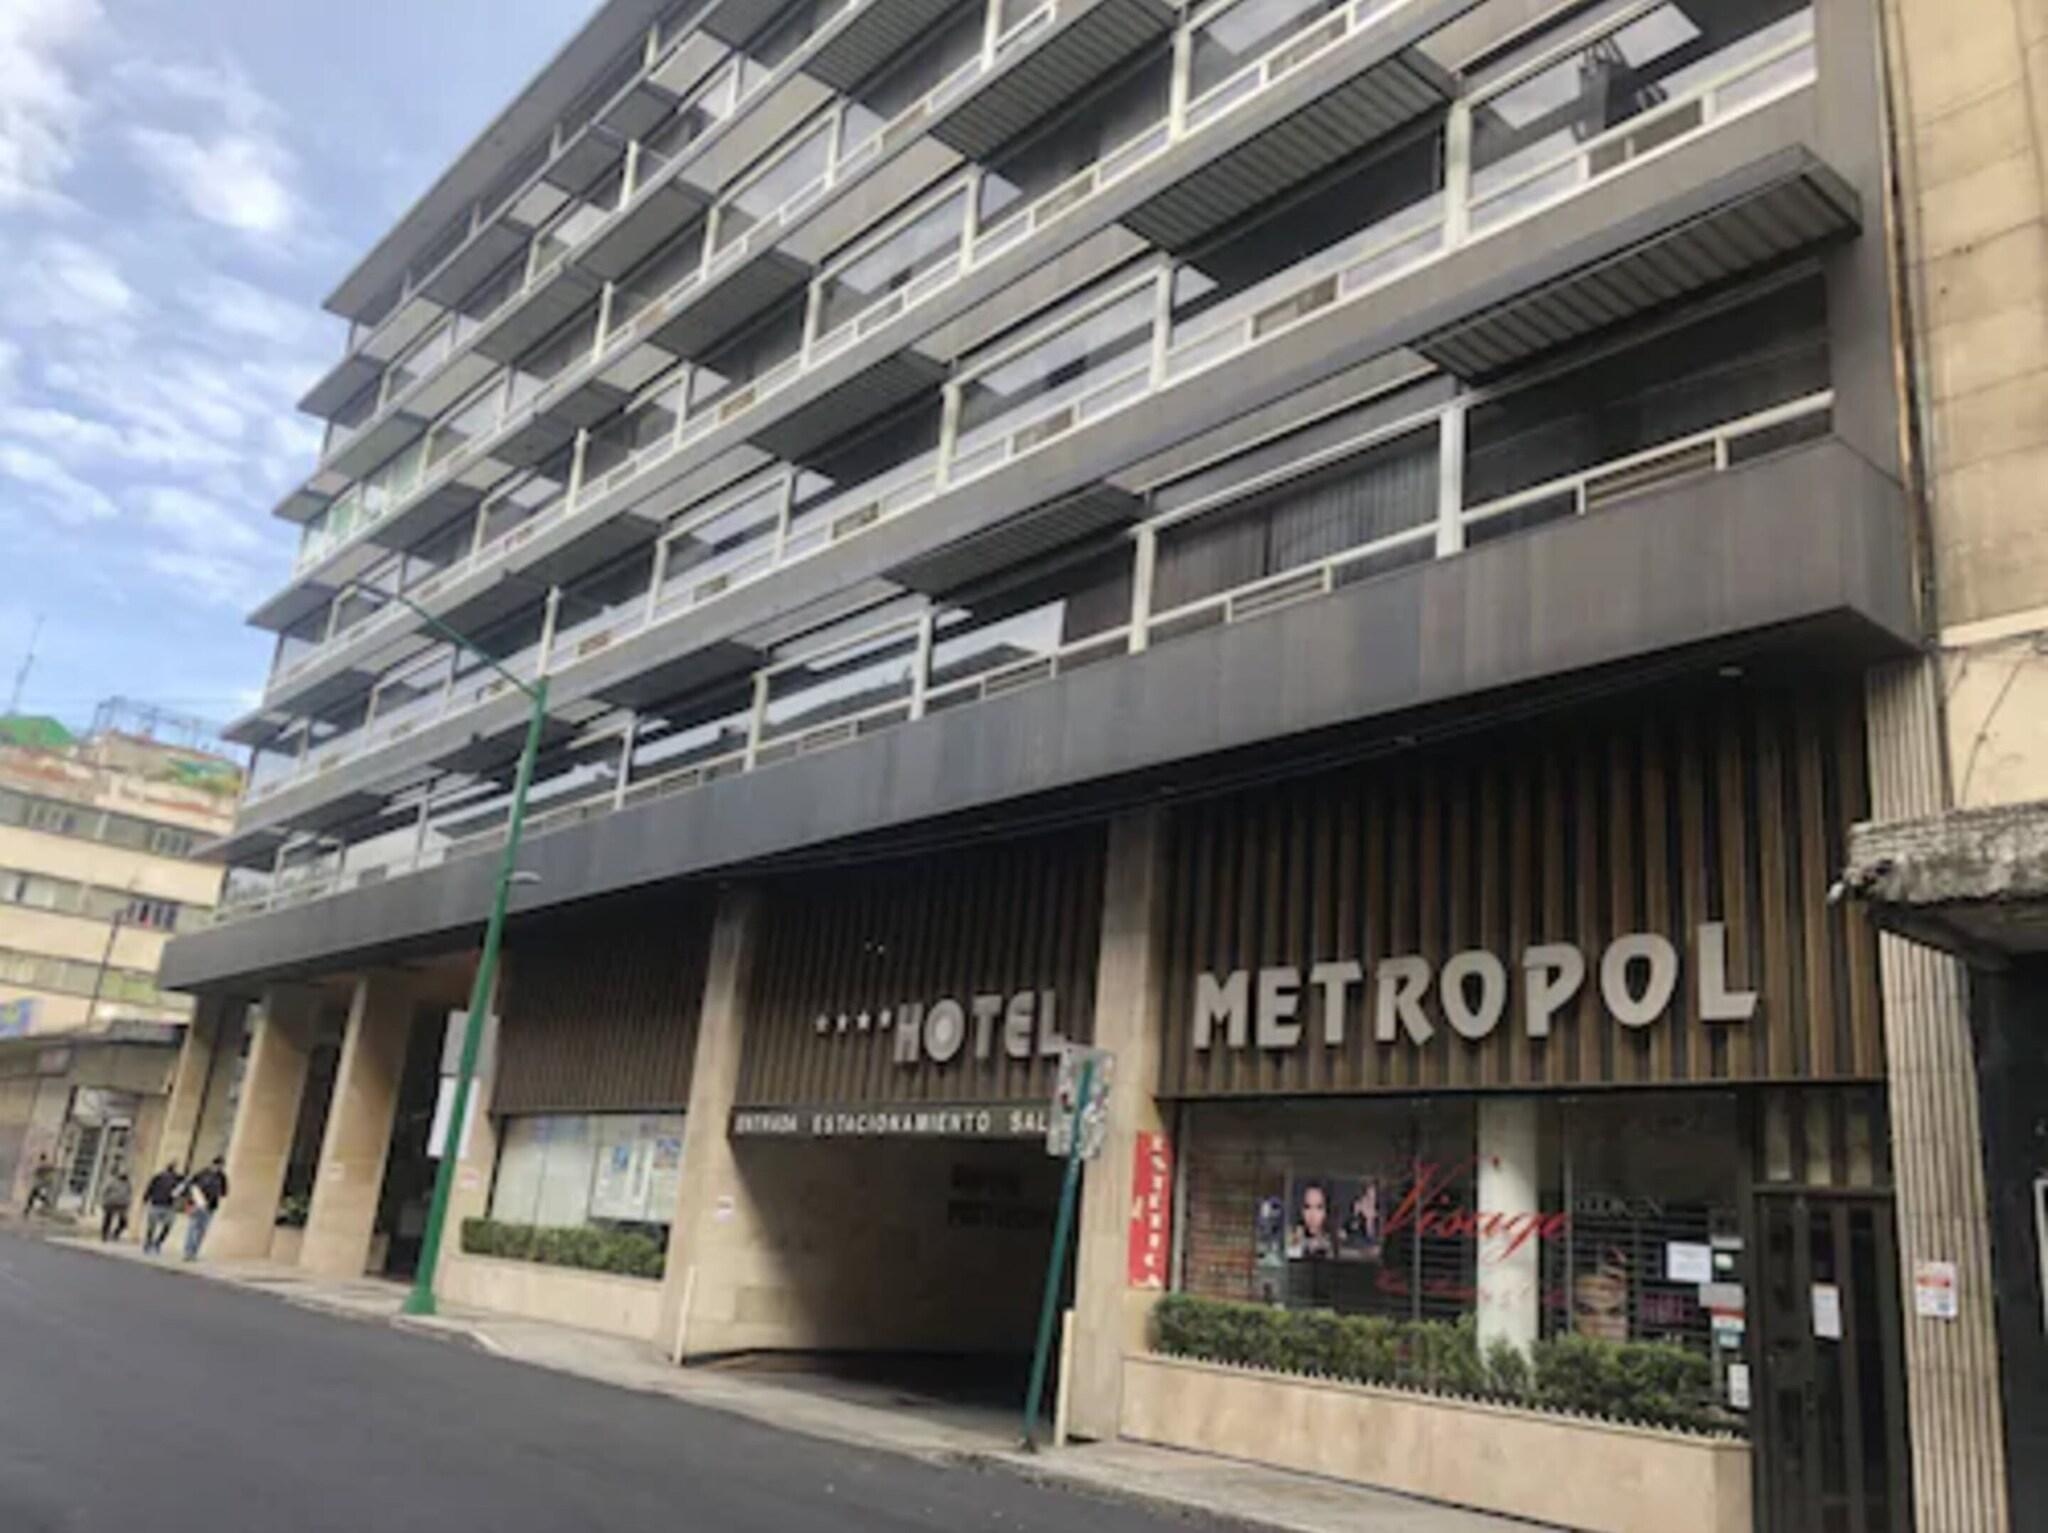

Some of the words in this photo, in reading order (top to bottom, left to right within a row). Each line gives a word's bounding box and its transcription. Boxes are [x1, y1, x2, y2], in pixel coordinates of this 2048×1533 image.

[893, 989, 1066, 1062] HOTEL
[1193, 922, 1758, 1049] METROPOL
[812, 1112, 991, 1134] ESTACIONAMIENTO
[1009, 1110, 1048, 1133] SAL
